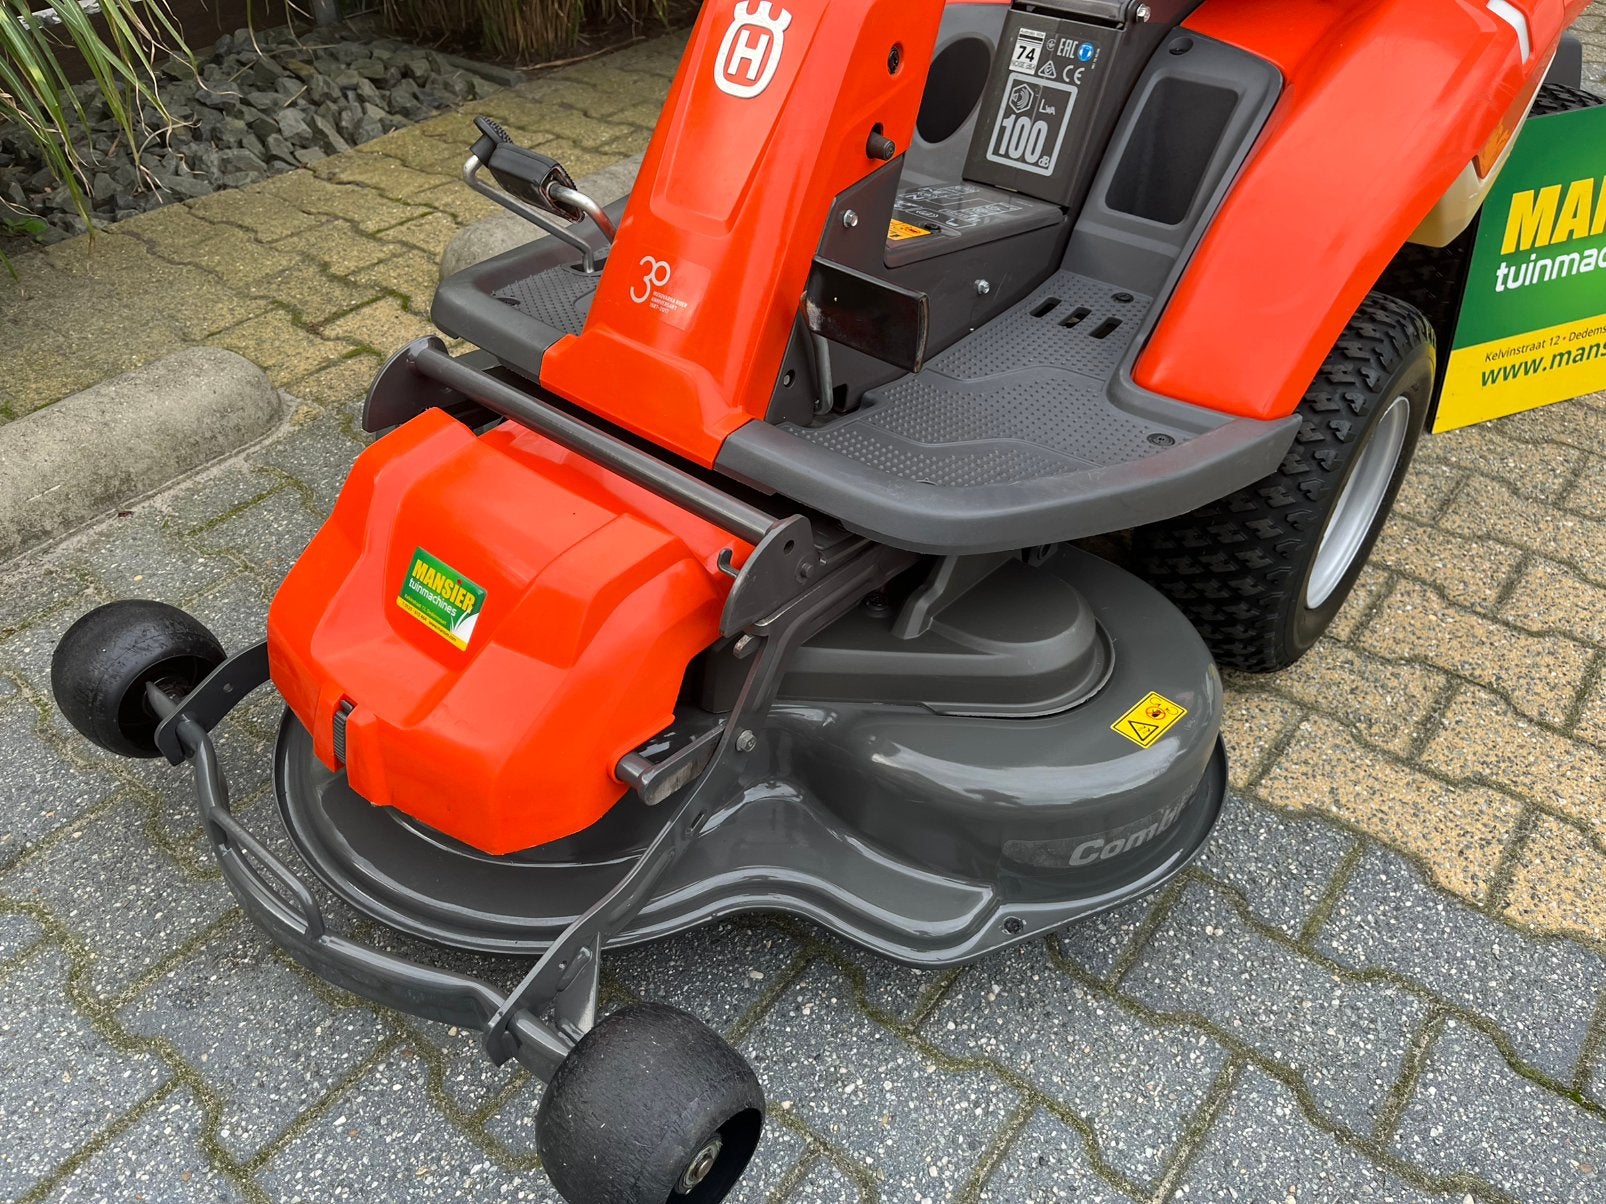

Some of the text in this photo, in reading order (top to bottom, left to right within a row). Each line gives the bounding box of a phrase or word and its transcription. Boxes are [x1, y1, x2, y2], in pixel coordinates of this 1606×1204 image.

[1017, 45, 1036, 63] 74
[1057, 38, 1078, 59] EAC
[1063, 65, 1085, 84] CE
[999, 114, 1048, 164] 100
[630, 255, 671, 304] 30
[1485, 325, 1606, 363] Kelvinstraat 12 Dedems
[409, 578, 457, 617] tuinmachines
[412, 559, 476, 614] MANSIER
